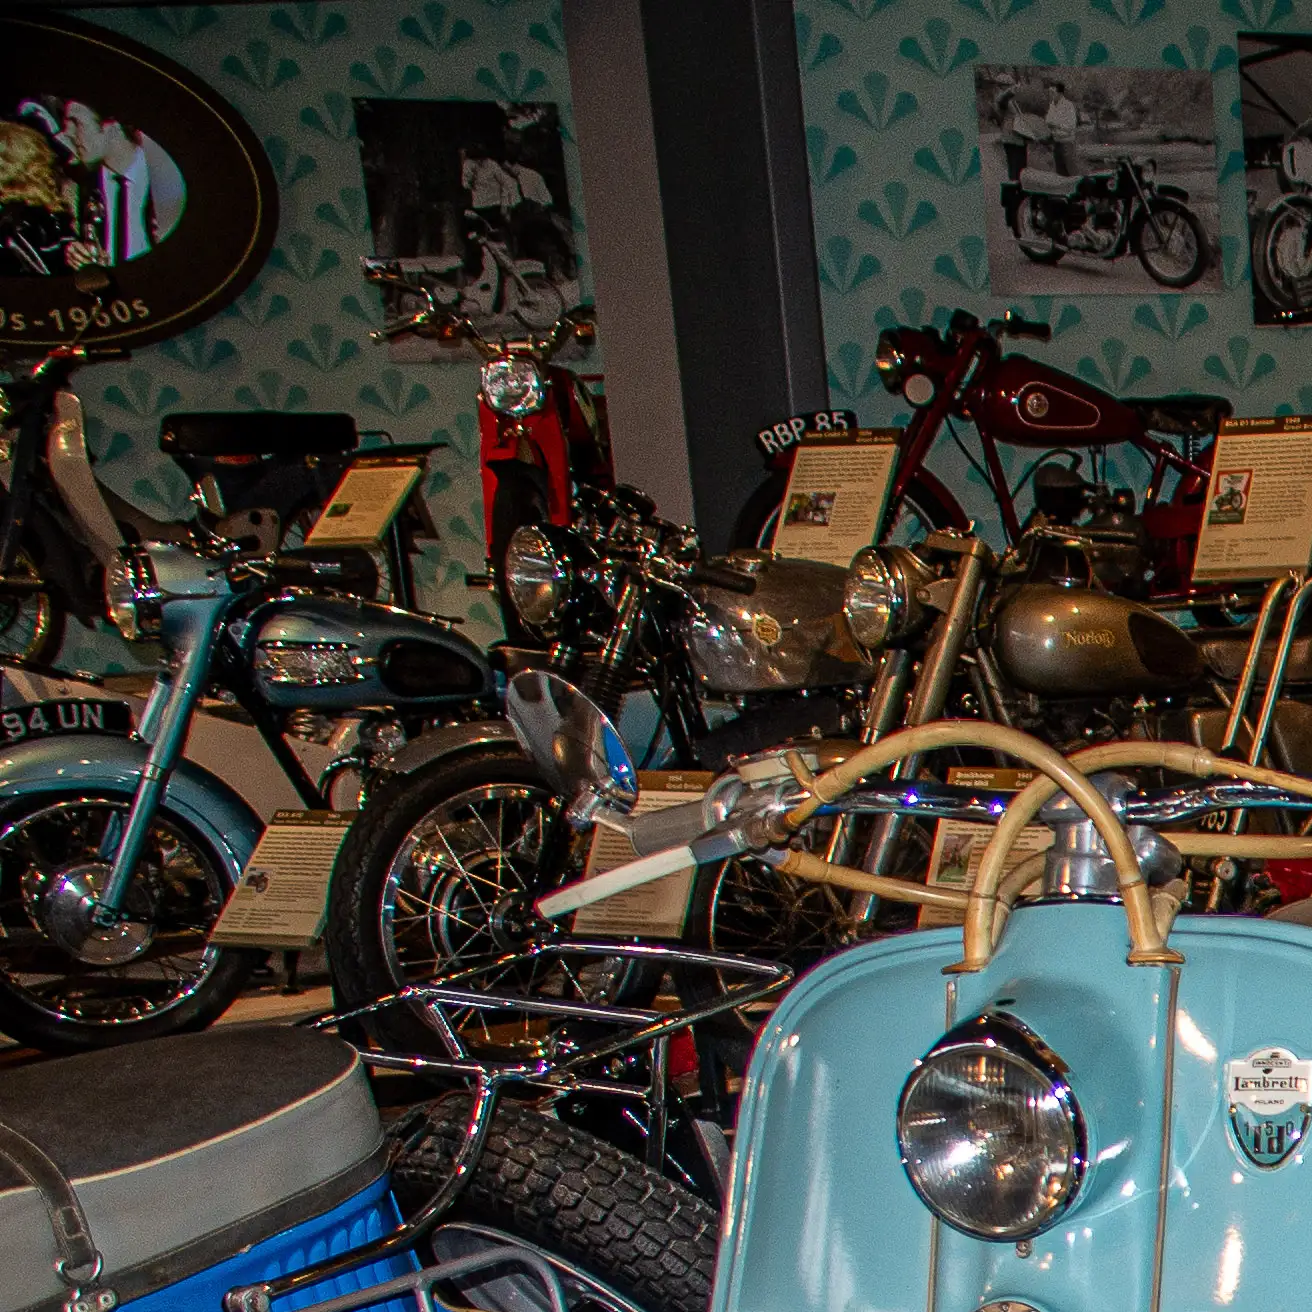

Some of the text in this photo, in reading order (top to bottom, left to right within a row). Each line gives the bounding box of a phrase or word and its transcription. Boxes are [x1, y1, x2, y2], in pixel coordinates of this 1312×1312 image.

[758, 417, 806, 455] RBP
[1061, 629, 1116, 649] Norton
[57, 703, 104, 729] UN
